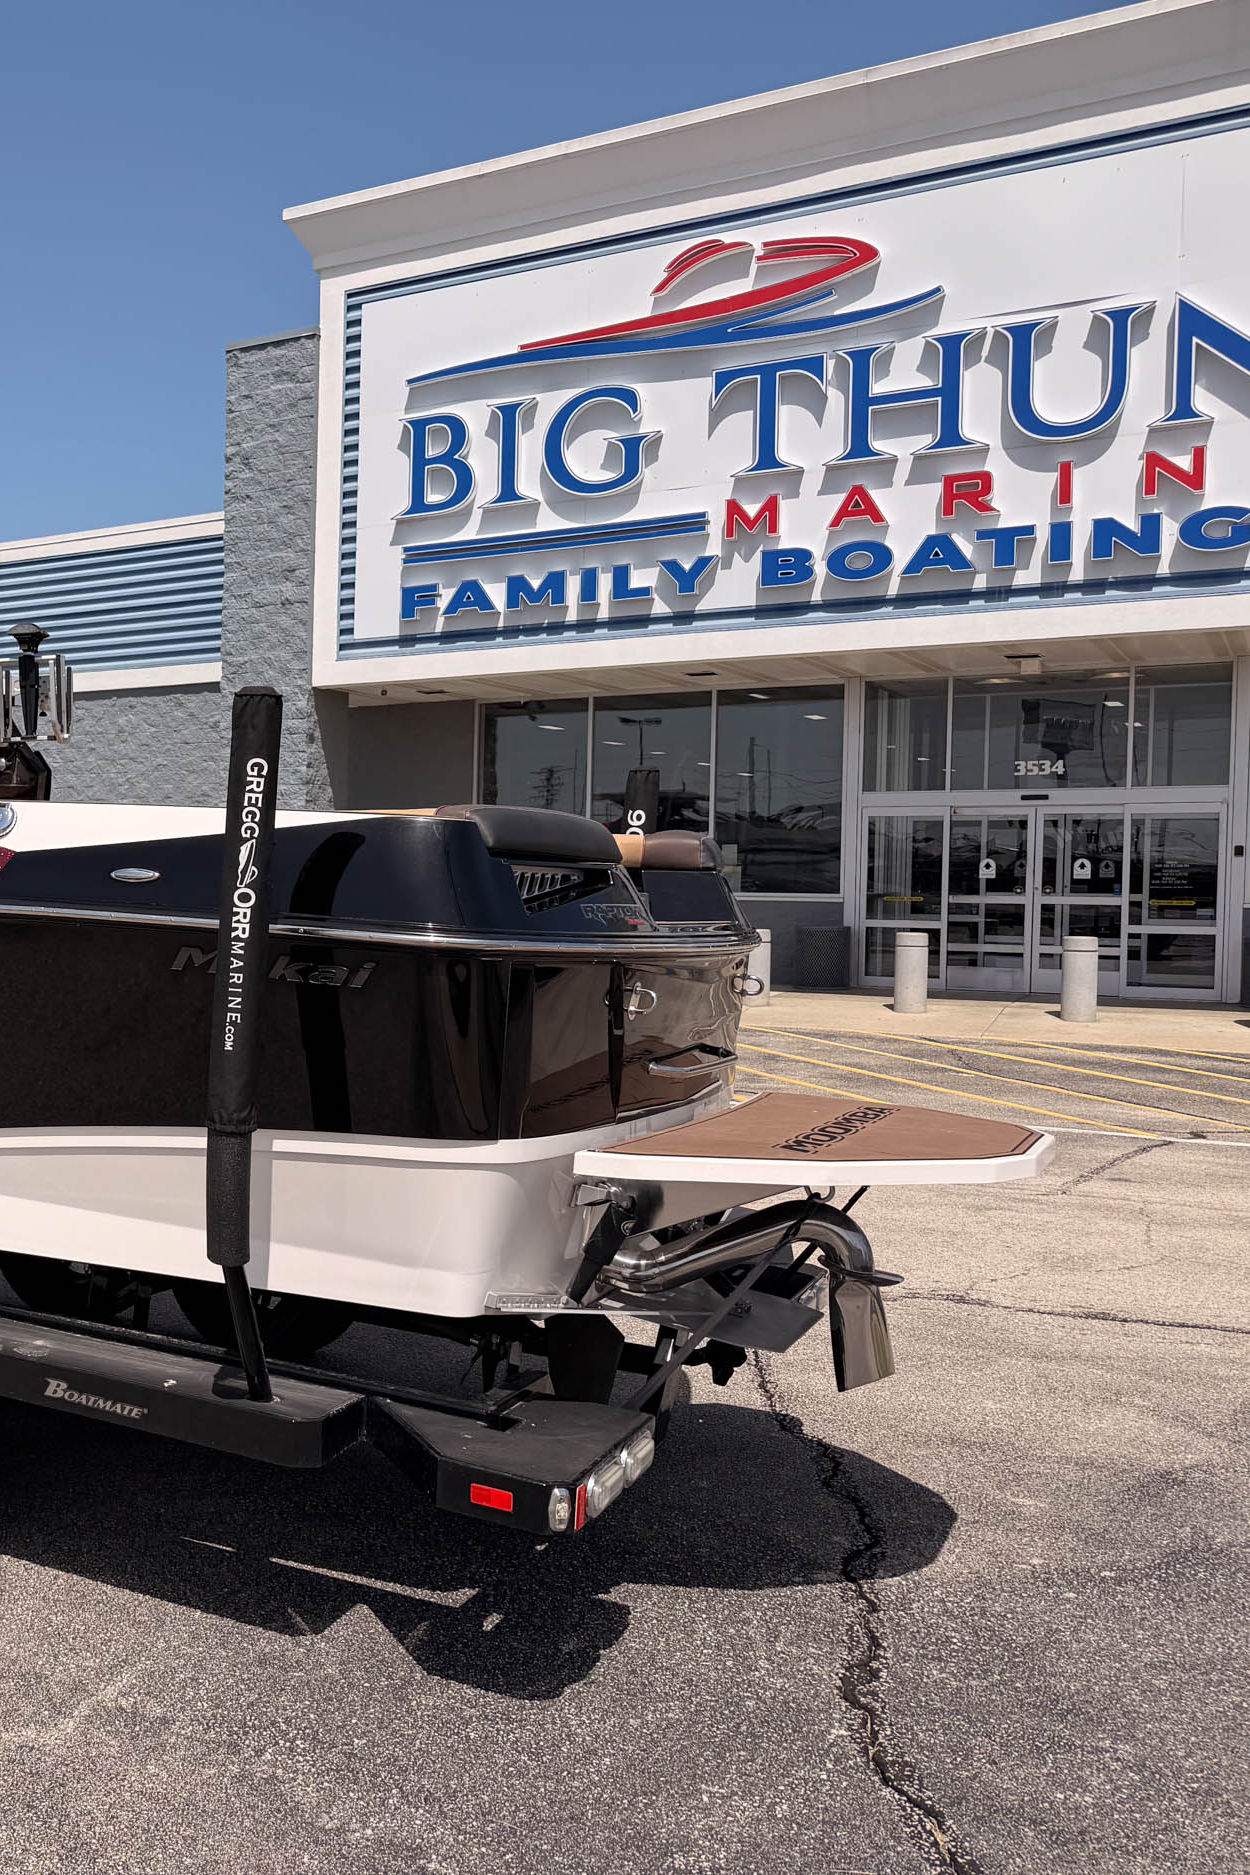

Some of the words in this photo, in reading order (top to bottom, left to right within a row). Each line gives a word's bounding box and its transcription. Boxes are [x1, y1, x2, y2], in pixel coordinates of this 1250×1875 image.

[390, 384, 662, 520] BIG
[724, 445, 1207, 539] MARIN
[401, 554, 720, 620] FAMILY
[760, 505, 1250, 588] BOATING
[240, 757, 269, 839] GREGG
[1014, 760, 1065, 776] 3534
[170, 947, 378, 988] Mkai
[777, 1106, 896, 1153] MOOMBA
